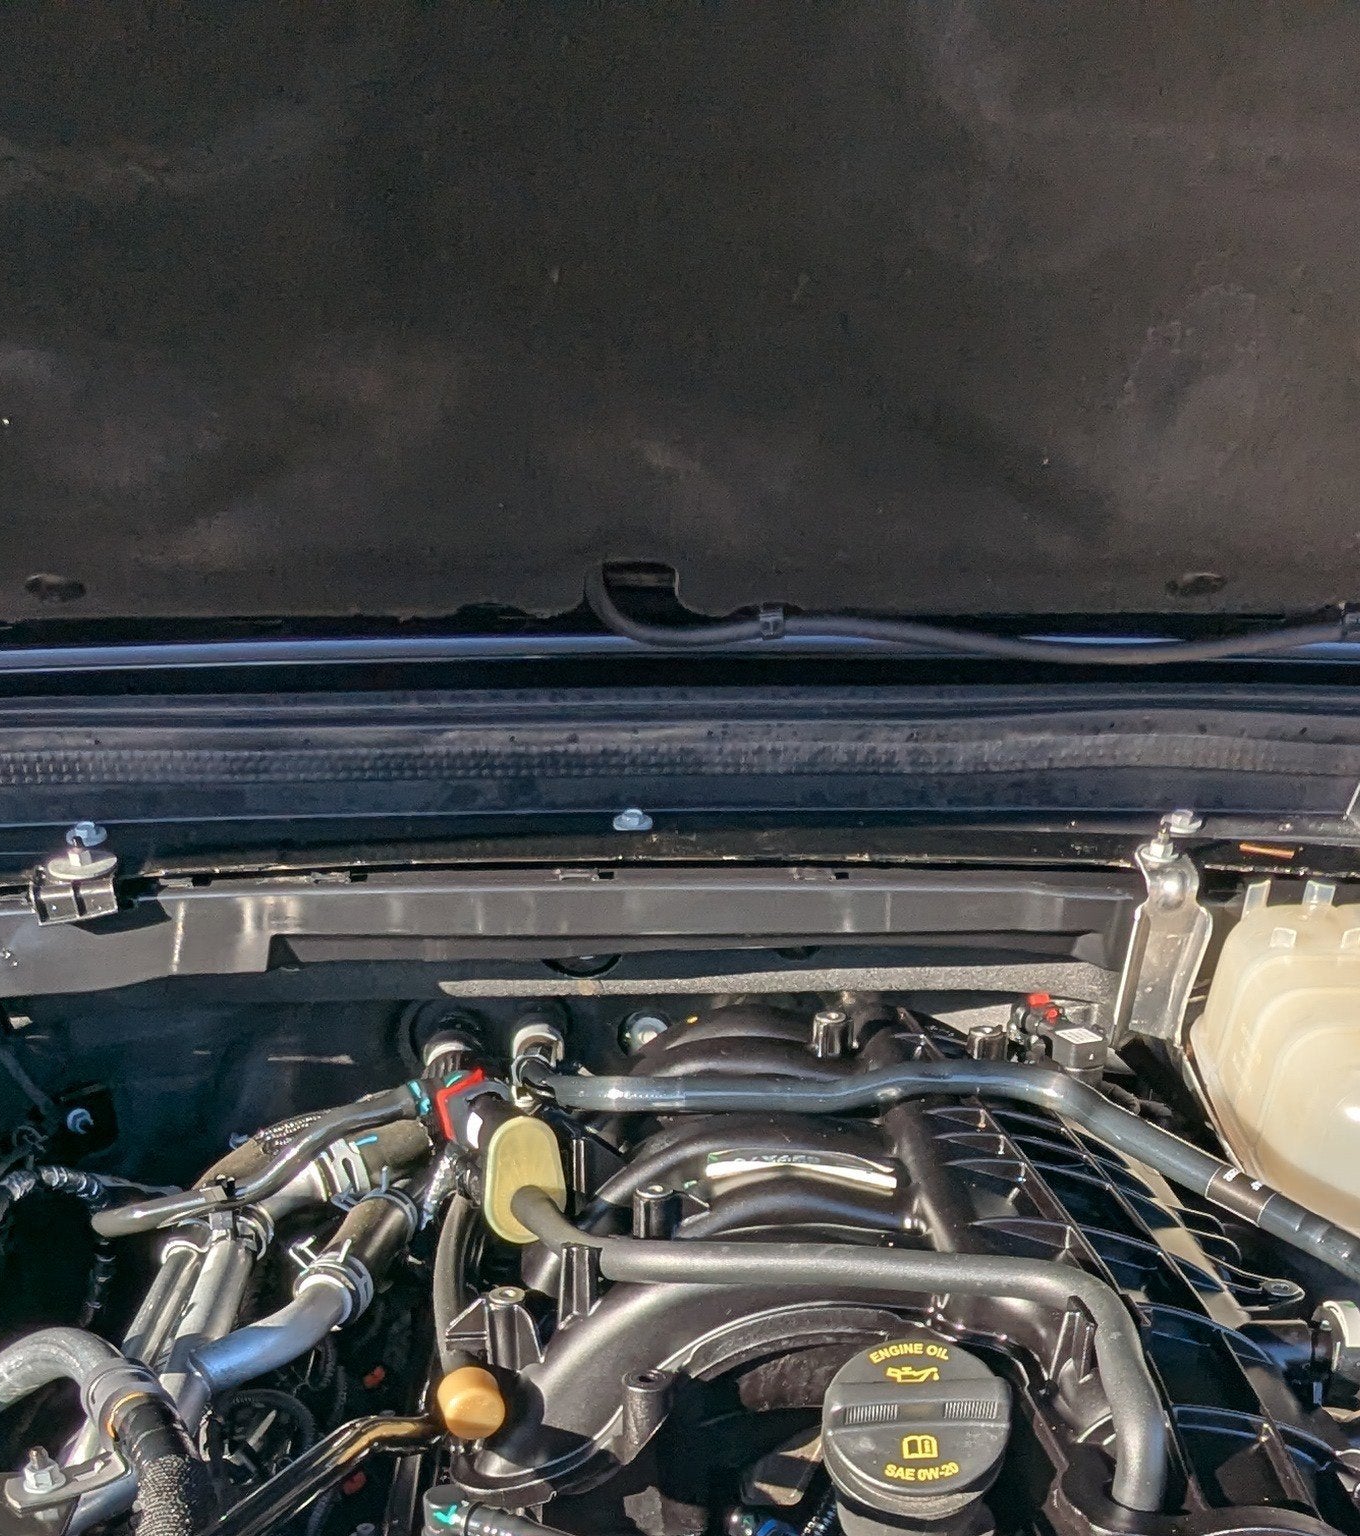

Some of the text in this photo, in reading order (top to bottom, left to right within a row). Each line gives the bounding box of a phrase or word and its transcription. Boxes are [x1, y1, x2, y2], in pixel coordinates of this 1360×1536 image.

[869, 1343, 949, 1363] ENGINE OIL
[885, 1462, 959, 1481] SAE 0W-20
